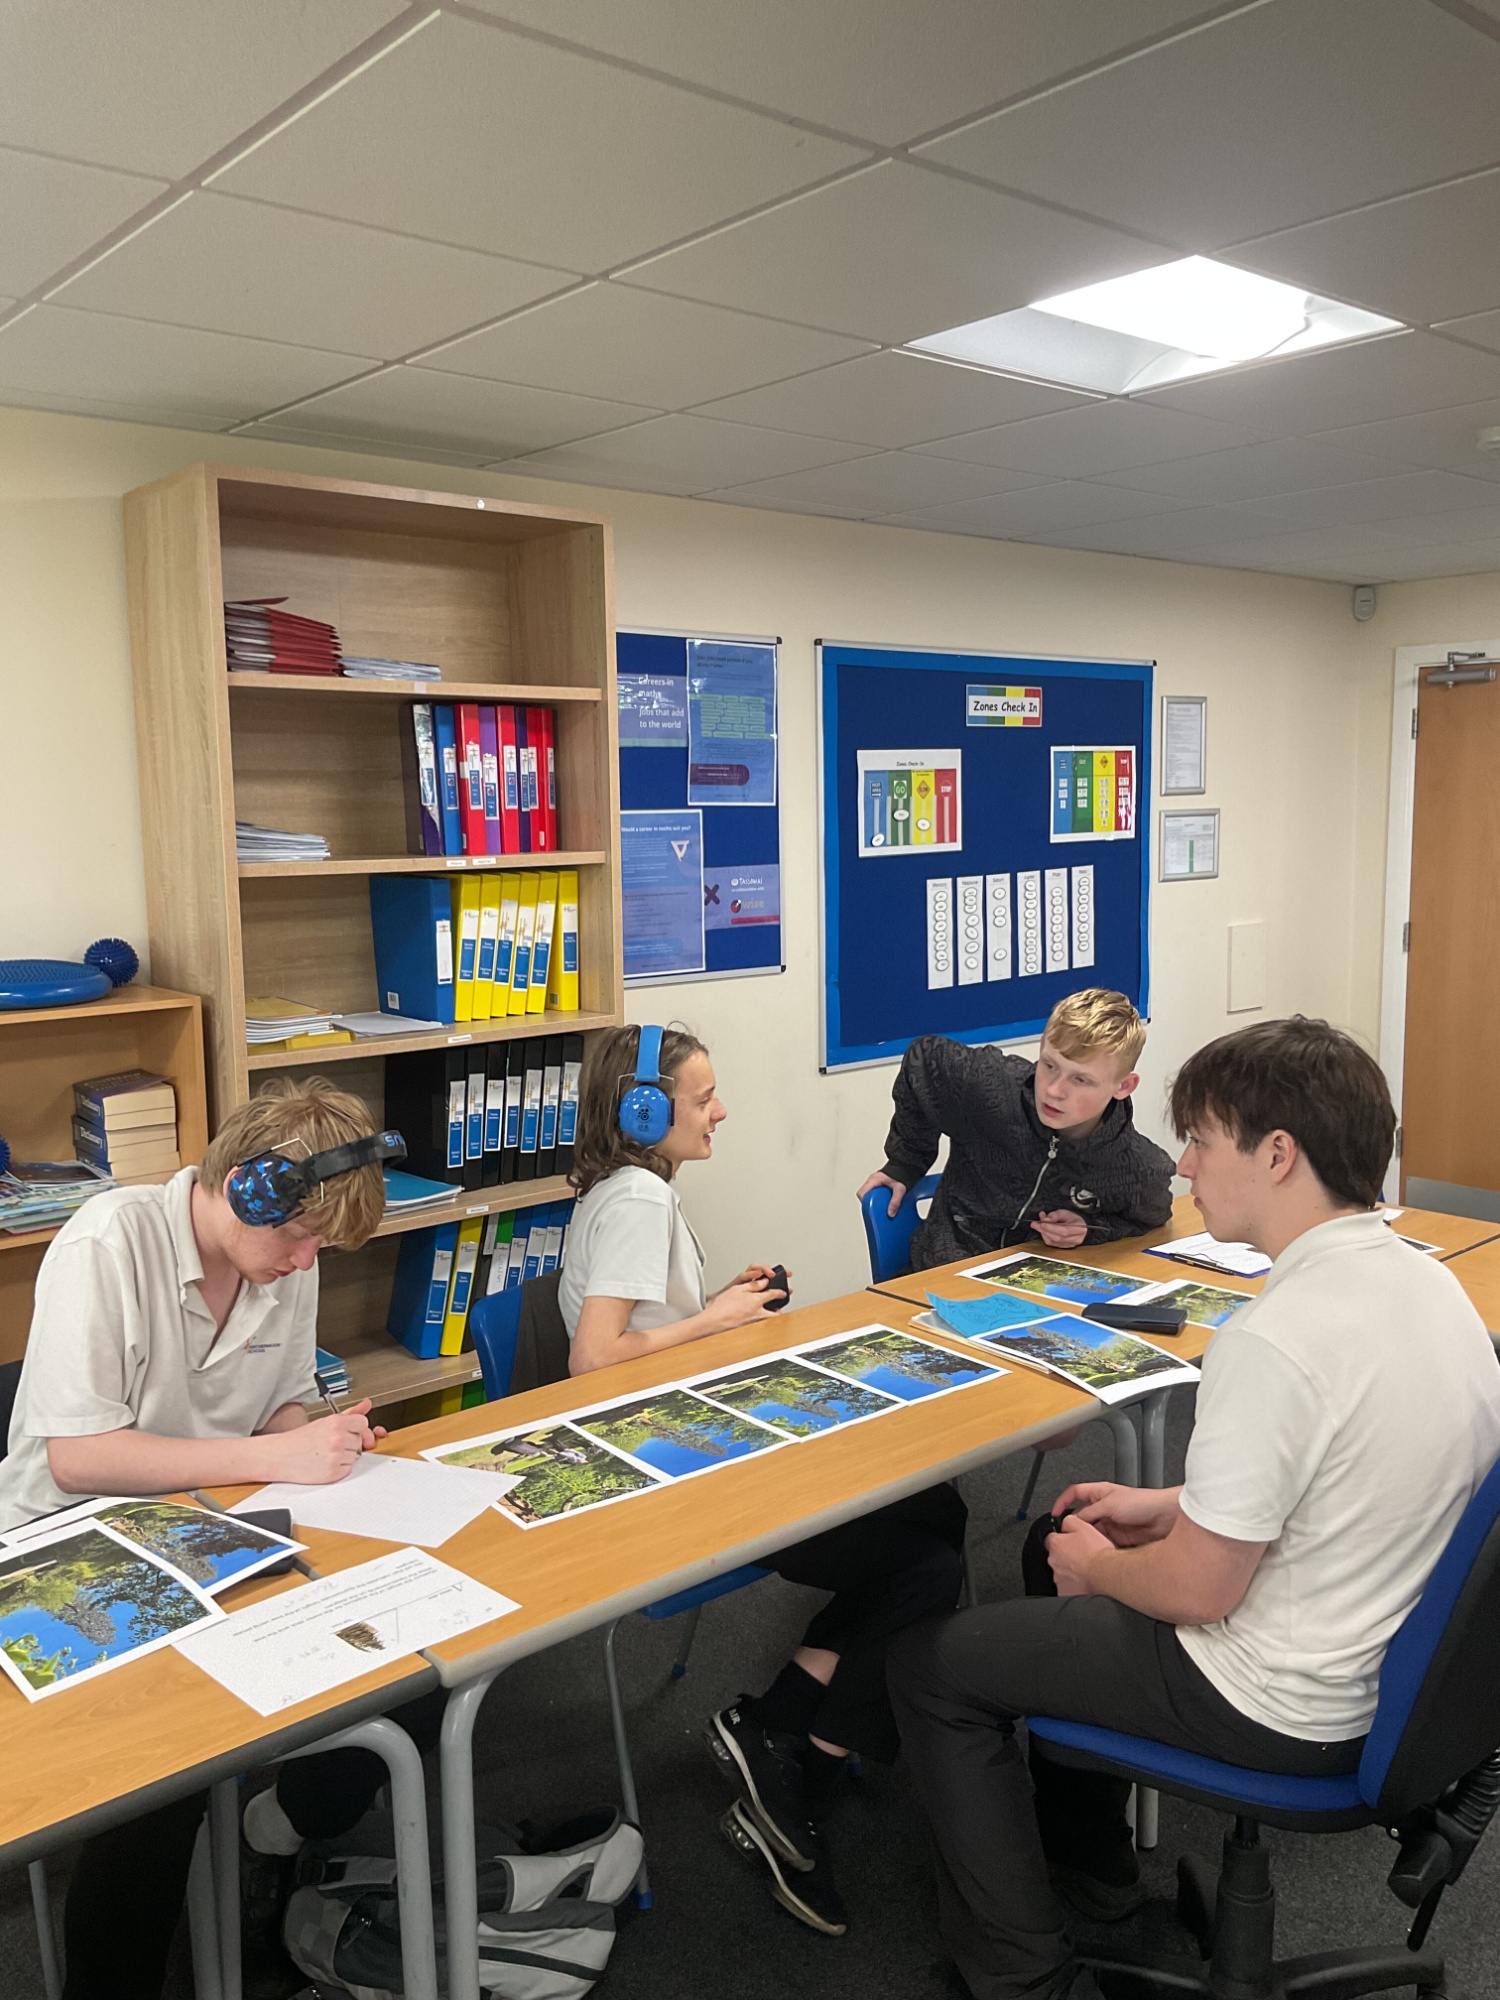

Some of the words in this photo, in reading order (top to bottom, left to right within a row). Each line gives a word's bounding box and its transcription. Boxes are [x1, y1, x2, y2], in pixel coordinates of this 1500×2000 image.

[973, 701, 998, 711] Zones
[1001, 701, 1026, 712] Check
[1028, 703, 1038, 712] In
[655, 709, 670, 717] that
[671, 709, 685, 717] add
[649, 720, 661, 728] the
[661, 721, 682, 729] world
[895, 786, 905, 794] GO
[728, 1708, 741, 1725] AIR
